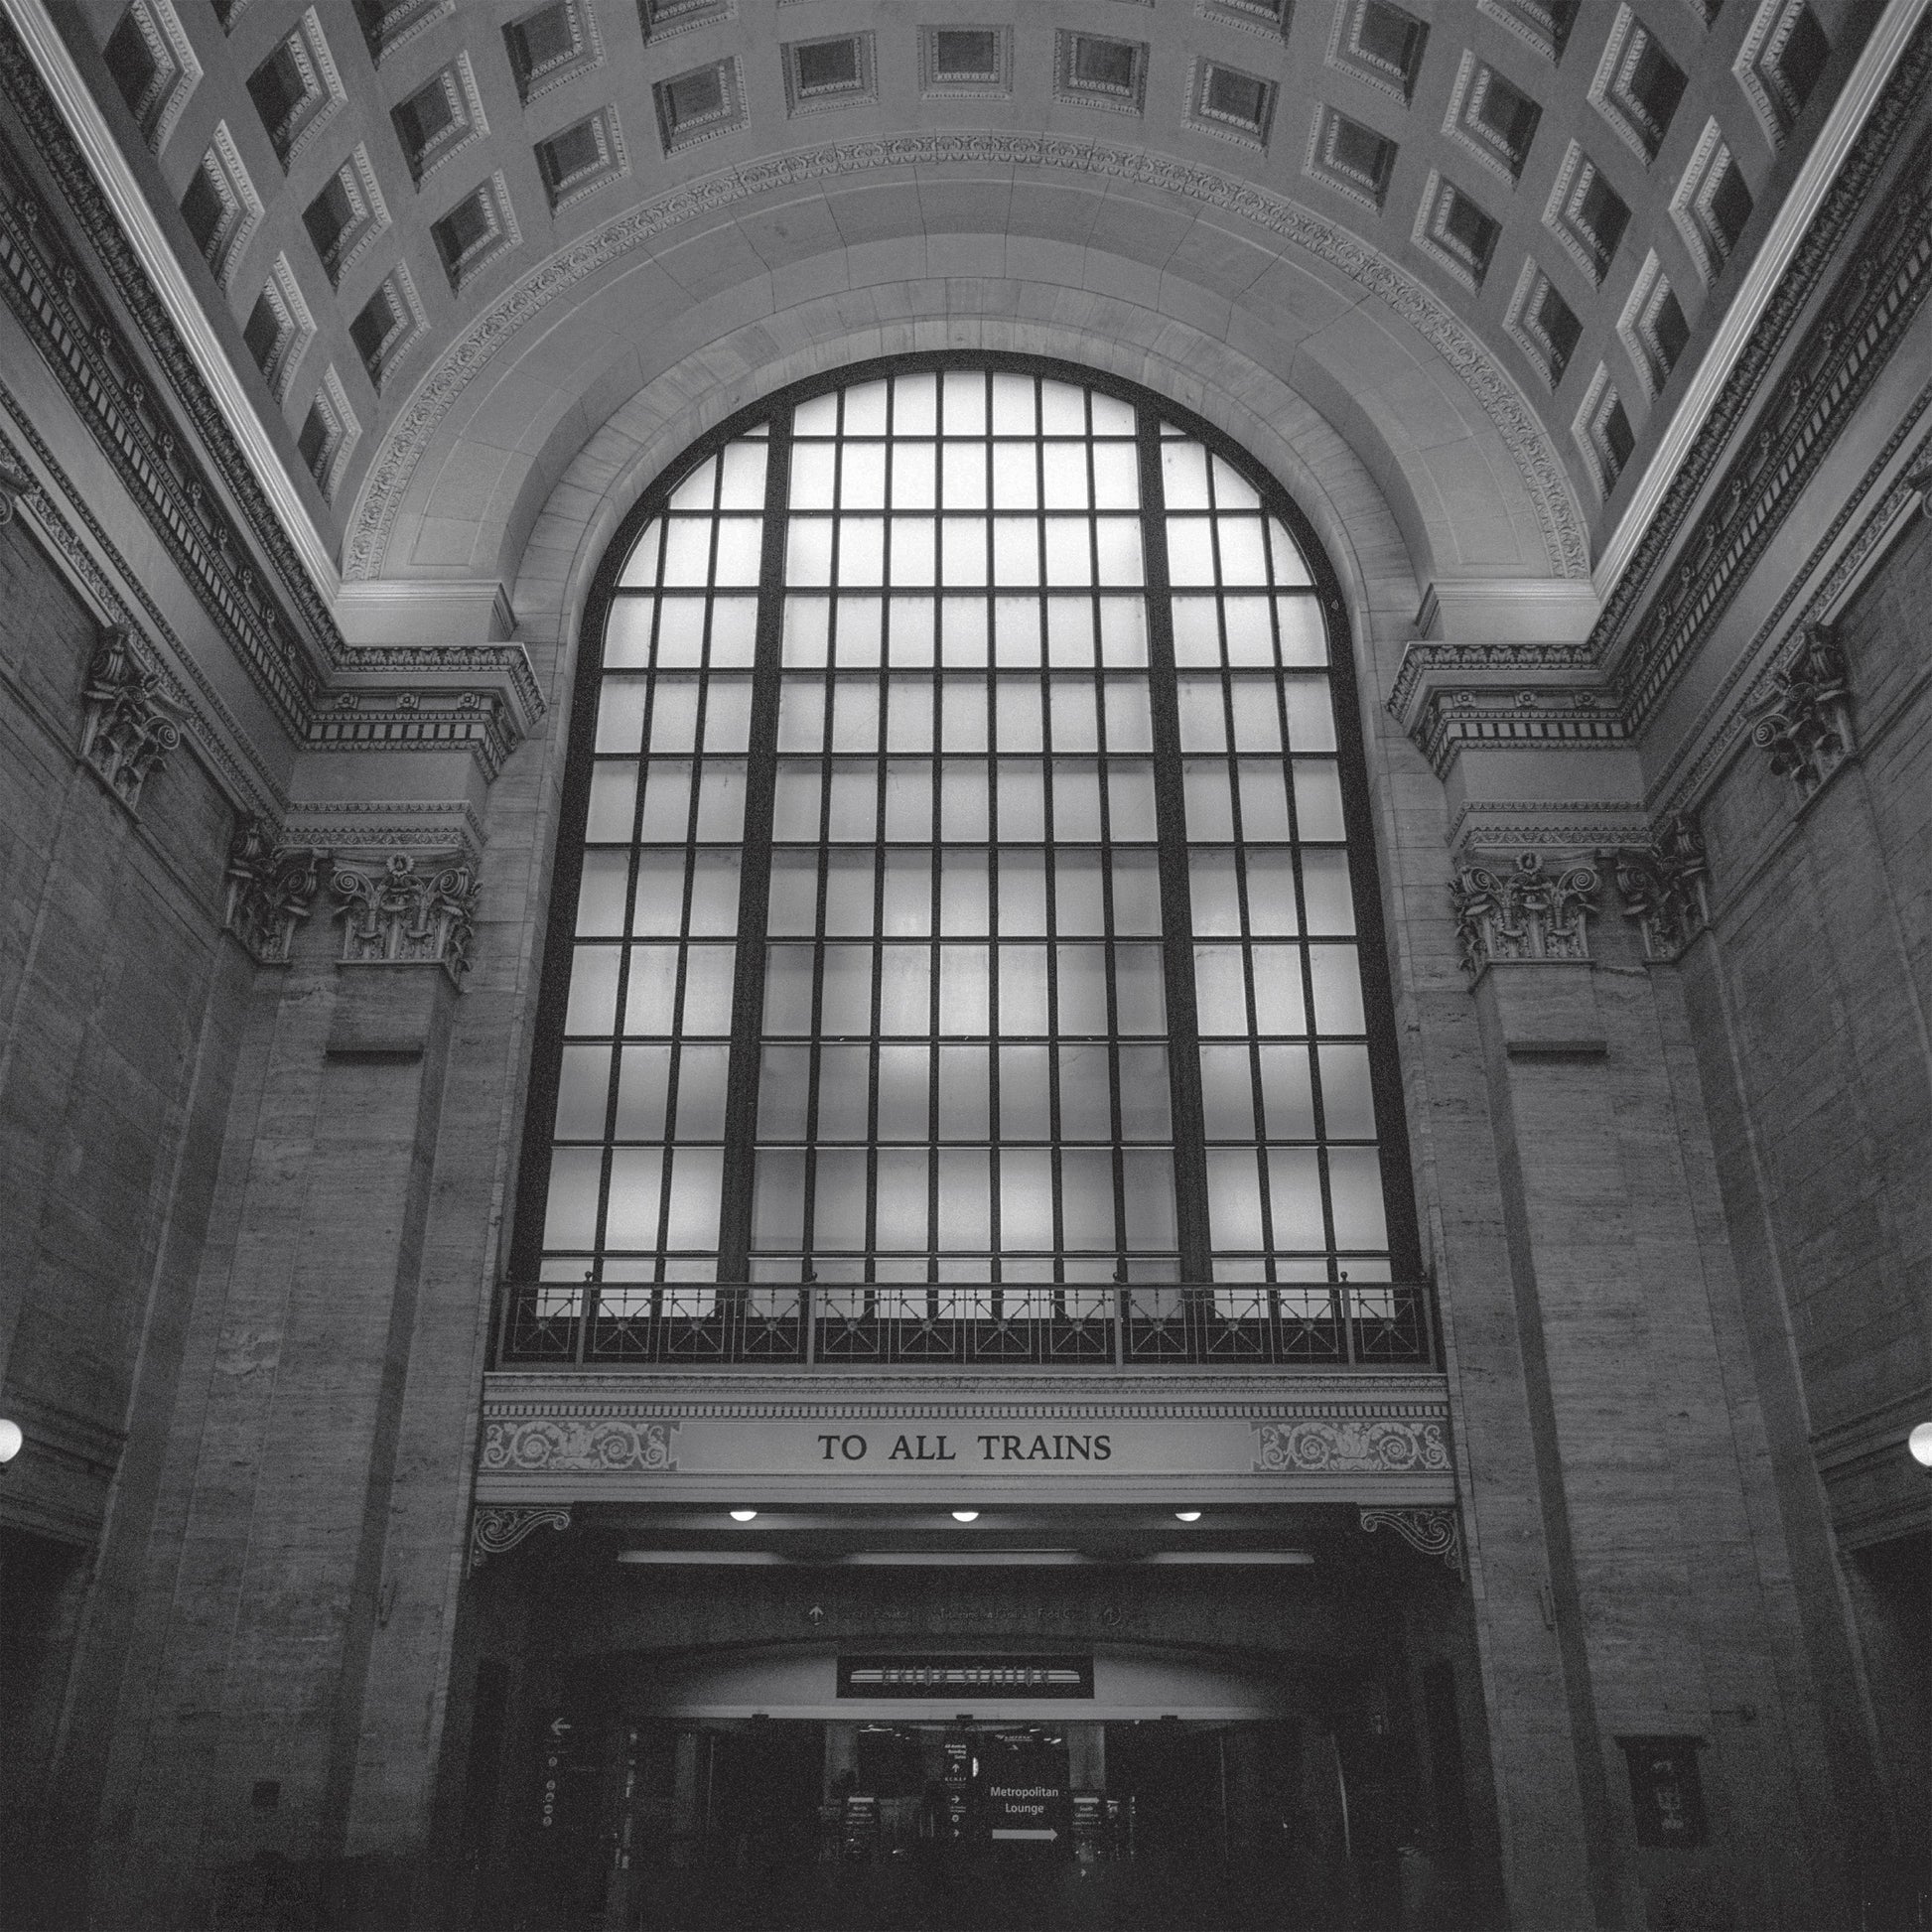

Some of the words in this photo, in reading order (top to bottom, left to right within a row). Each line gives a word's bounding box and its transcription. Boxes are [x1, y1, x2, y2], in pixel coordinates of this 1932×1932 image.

[818, 1434, 867, 1460] TO
[889, 1435, 956, 1459] ALL
[977, 1434, 1112, 1460] TRAINS
[882, 1665, 947, 1687] UNION
[962, 1665, 1049, 1687] STATION
[990, 1786, 1059, 1799] Metropolitan
[1005, 1802, 1044, 1815] Lounge
